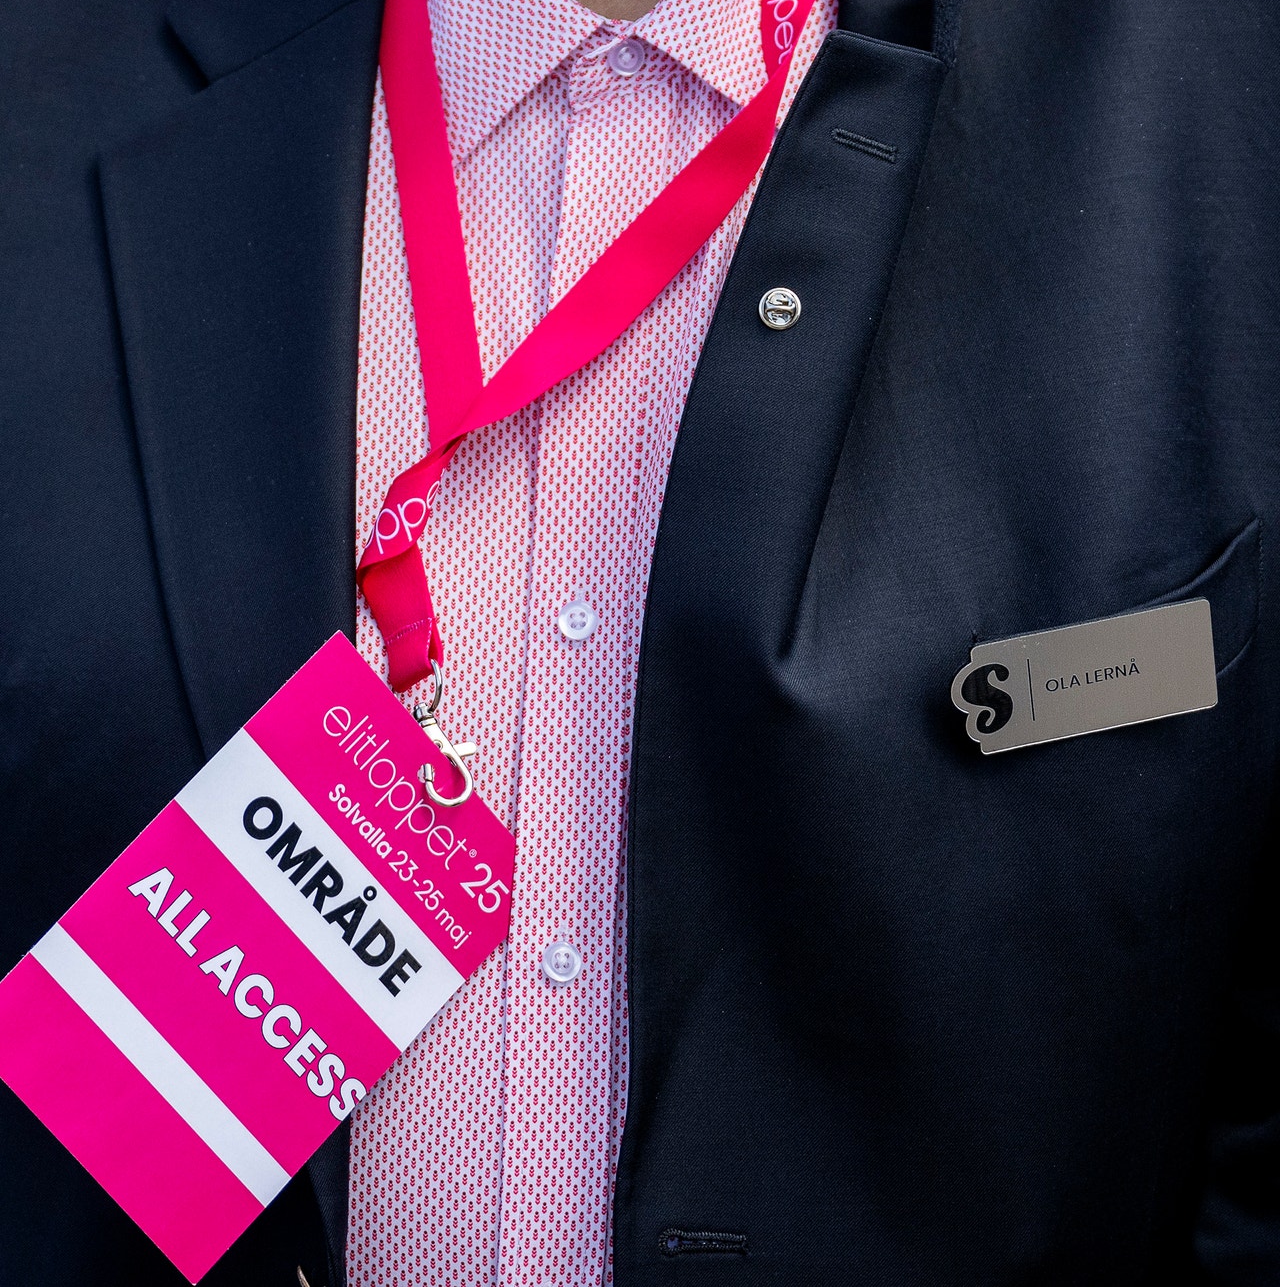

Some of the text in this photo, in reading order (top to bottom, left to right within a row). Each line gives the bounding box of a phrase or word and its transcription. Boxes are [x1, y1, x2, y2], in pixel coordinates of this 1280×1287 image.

[1045, 657, 1141, 693] OLA LERNÅ
[243, 796, 423, 998] OMRÅDE
[328, 783, 472, 950] Solvalla 23-25 maj
[460, 863, 510, 913] 25
[127, 867, 367, 1122] ALL ACCESS
